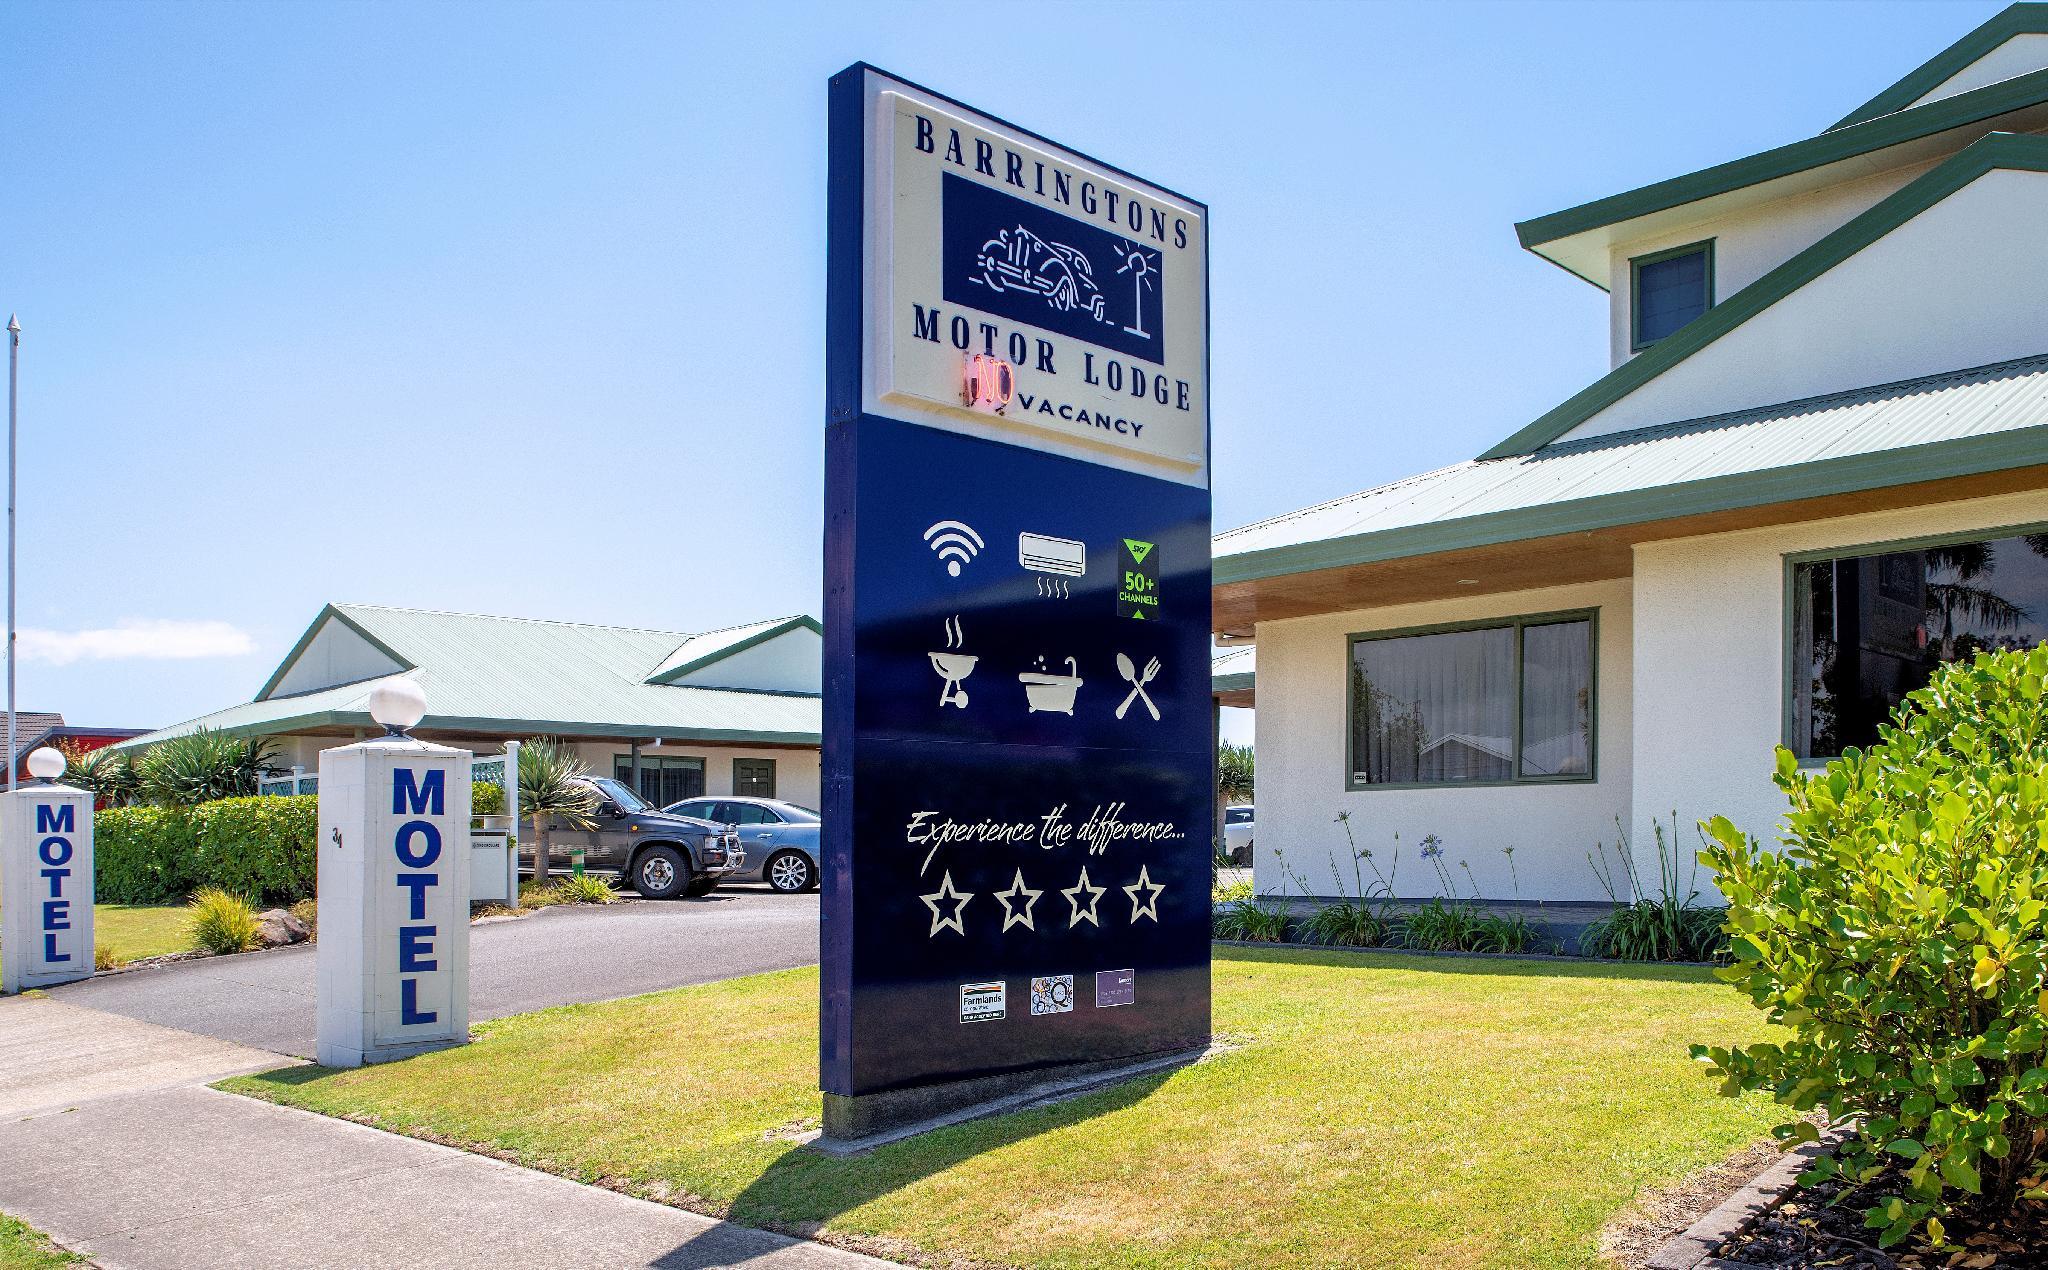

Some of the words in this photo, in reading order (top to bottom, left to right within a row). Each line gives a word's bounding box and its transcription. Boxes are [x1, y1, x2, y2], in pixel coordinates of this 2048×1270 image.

[915, 114, 1187, 249] BARRINGTONS
[912, 304, 1056, 375] MOTOR
[1084, 352, 1191, 412] LODGE
[974, 355, 1014, 404] NO
[1018, 391, 1144, 438] VACANCY
[1119, 591, 1158, 606] CHANNELS
[1125, 570, 1155, 593] 50+
[906, 810, 1036, 877] Experience
[1039, 802, 1072, 850] the
[36, 804, 75, 963] MOTEL
[392, 767, 445, 1026] MOTEL
[963, 994, 1002, 1006] Farmlands
